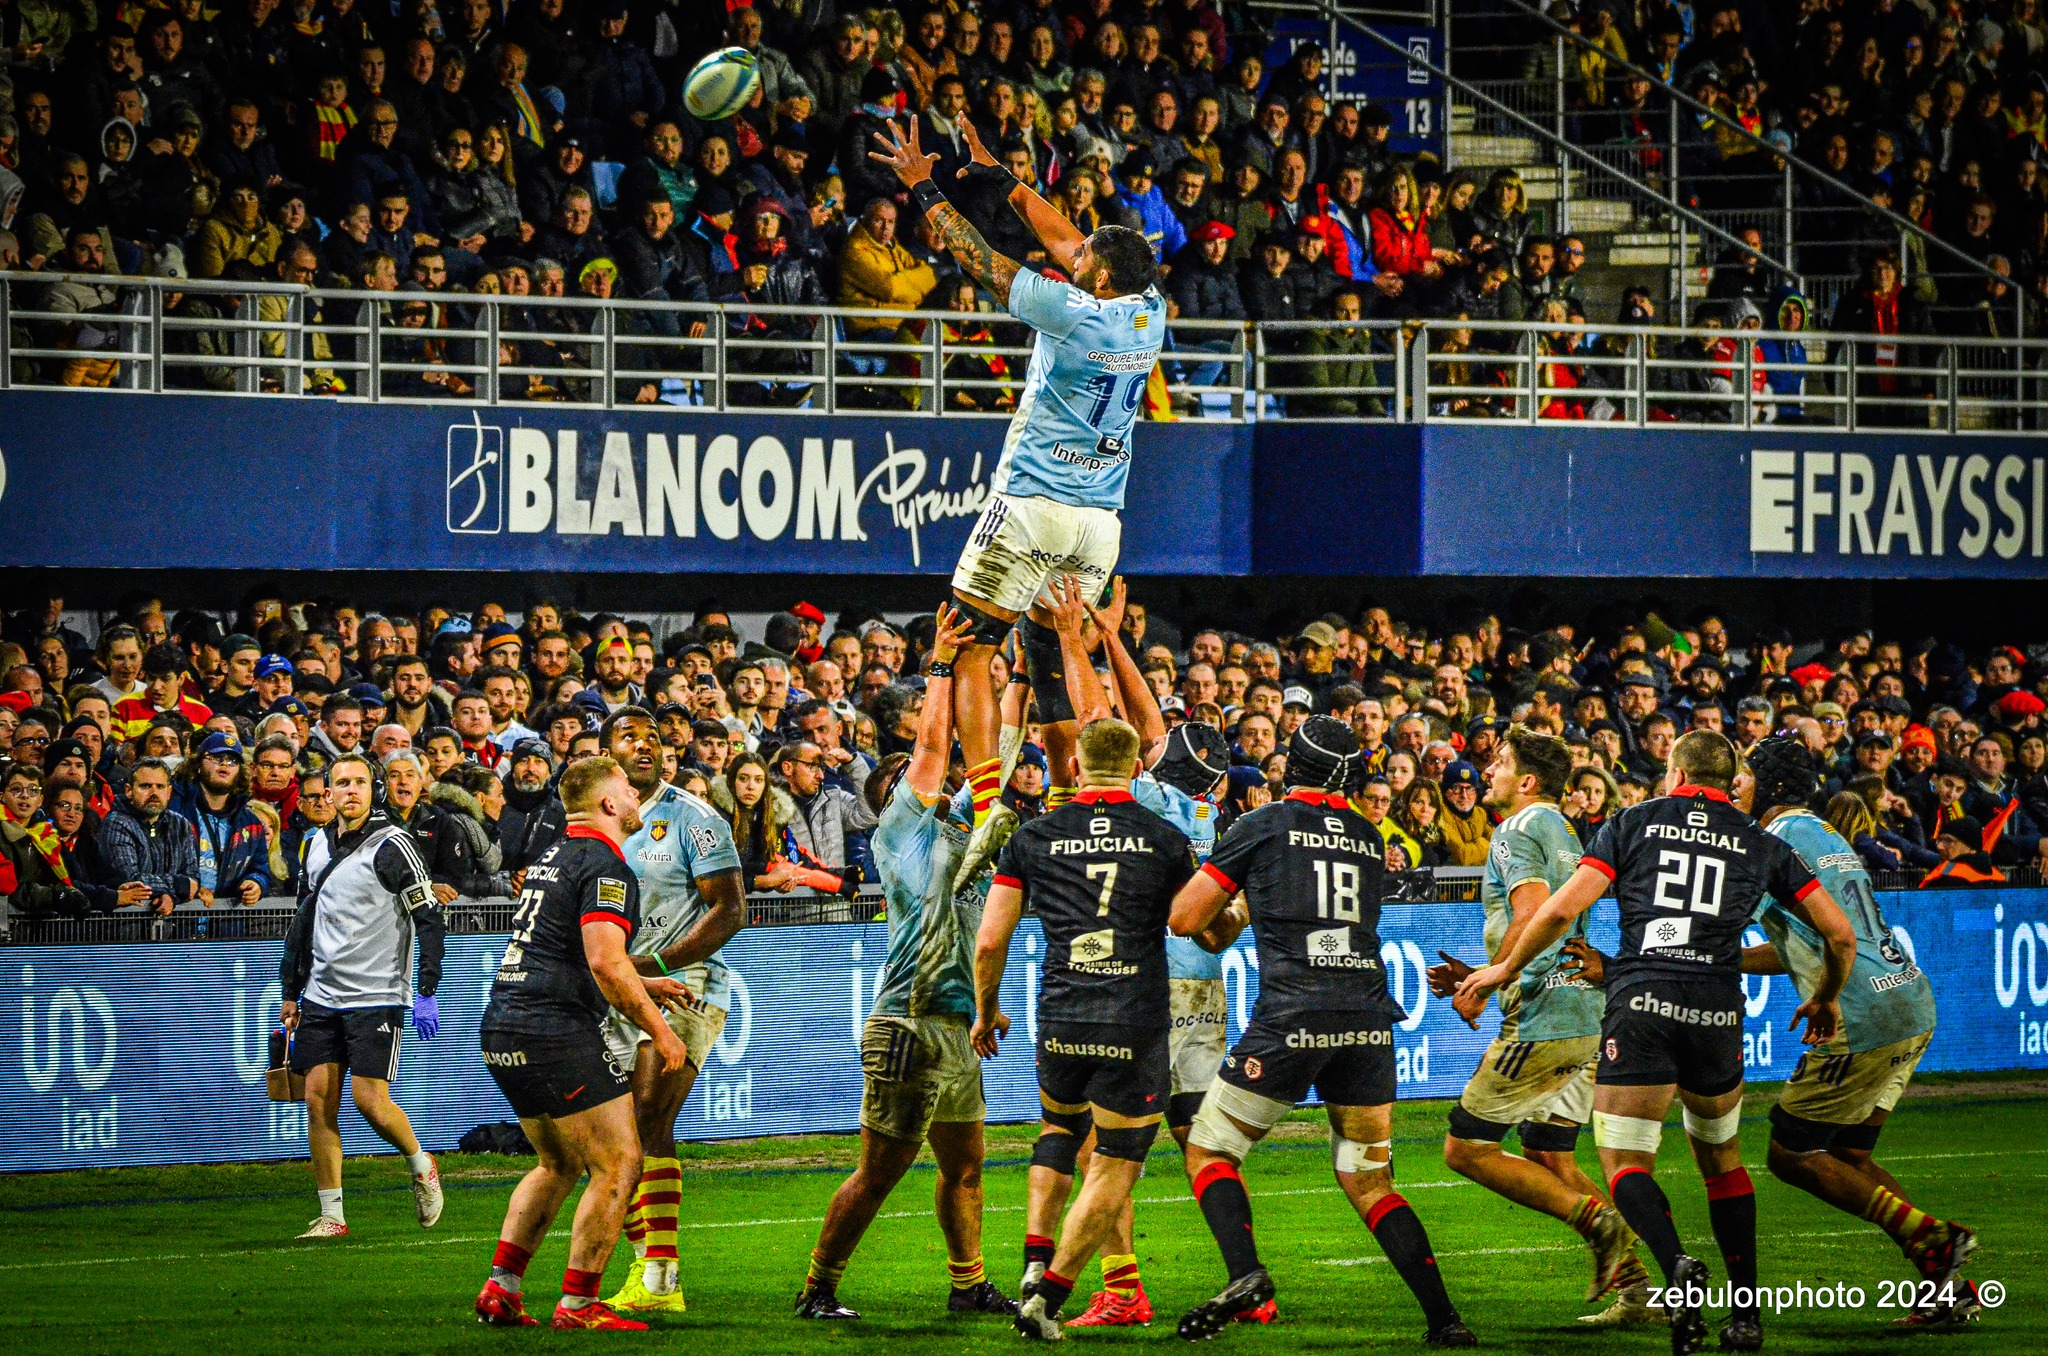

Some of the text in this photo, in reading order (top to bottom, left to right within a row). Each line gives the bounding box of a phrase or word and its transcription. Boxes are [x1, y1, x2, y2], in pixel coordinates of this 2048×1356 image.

[1405, 98, 1432, 139] 13
[1087, 350, 1133, 364] GROUPE
[508, 427, 858, 541] BLANCOM
[1049, 836, 1154, 856] FIDUCIAL
[1287, 829, 1383, 862] FIDUCIAL
[1644, 823, 1748, 856] FIDUCIAL
[1086, 861, 1119, 918] 7
[1312, 859, 1361, 924] 18
[1653, 849, 1726, 918] 20
[1308, 955, 1378, 970] TOULOUSE
[1629, 991, 1737, 1027] chausson
[1044, 1037, 1133, 1060] chausson
[1284, 1028, 1392, 1049] chausson
[1743, 1020, 1772, 1067] ad
[1395, 1034, 1430, 1083] ad
